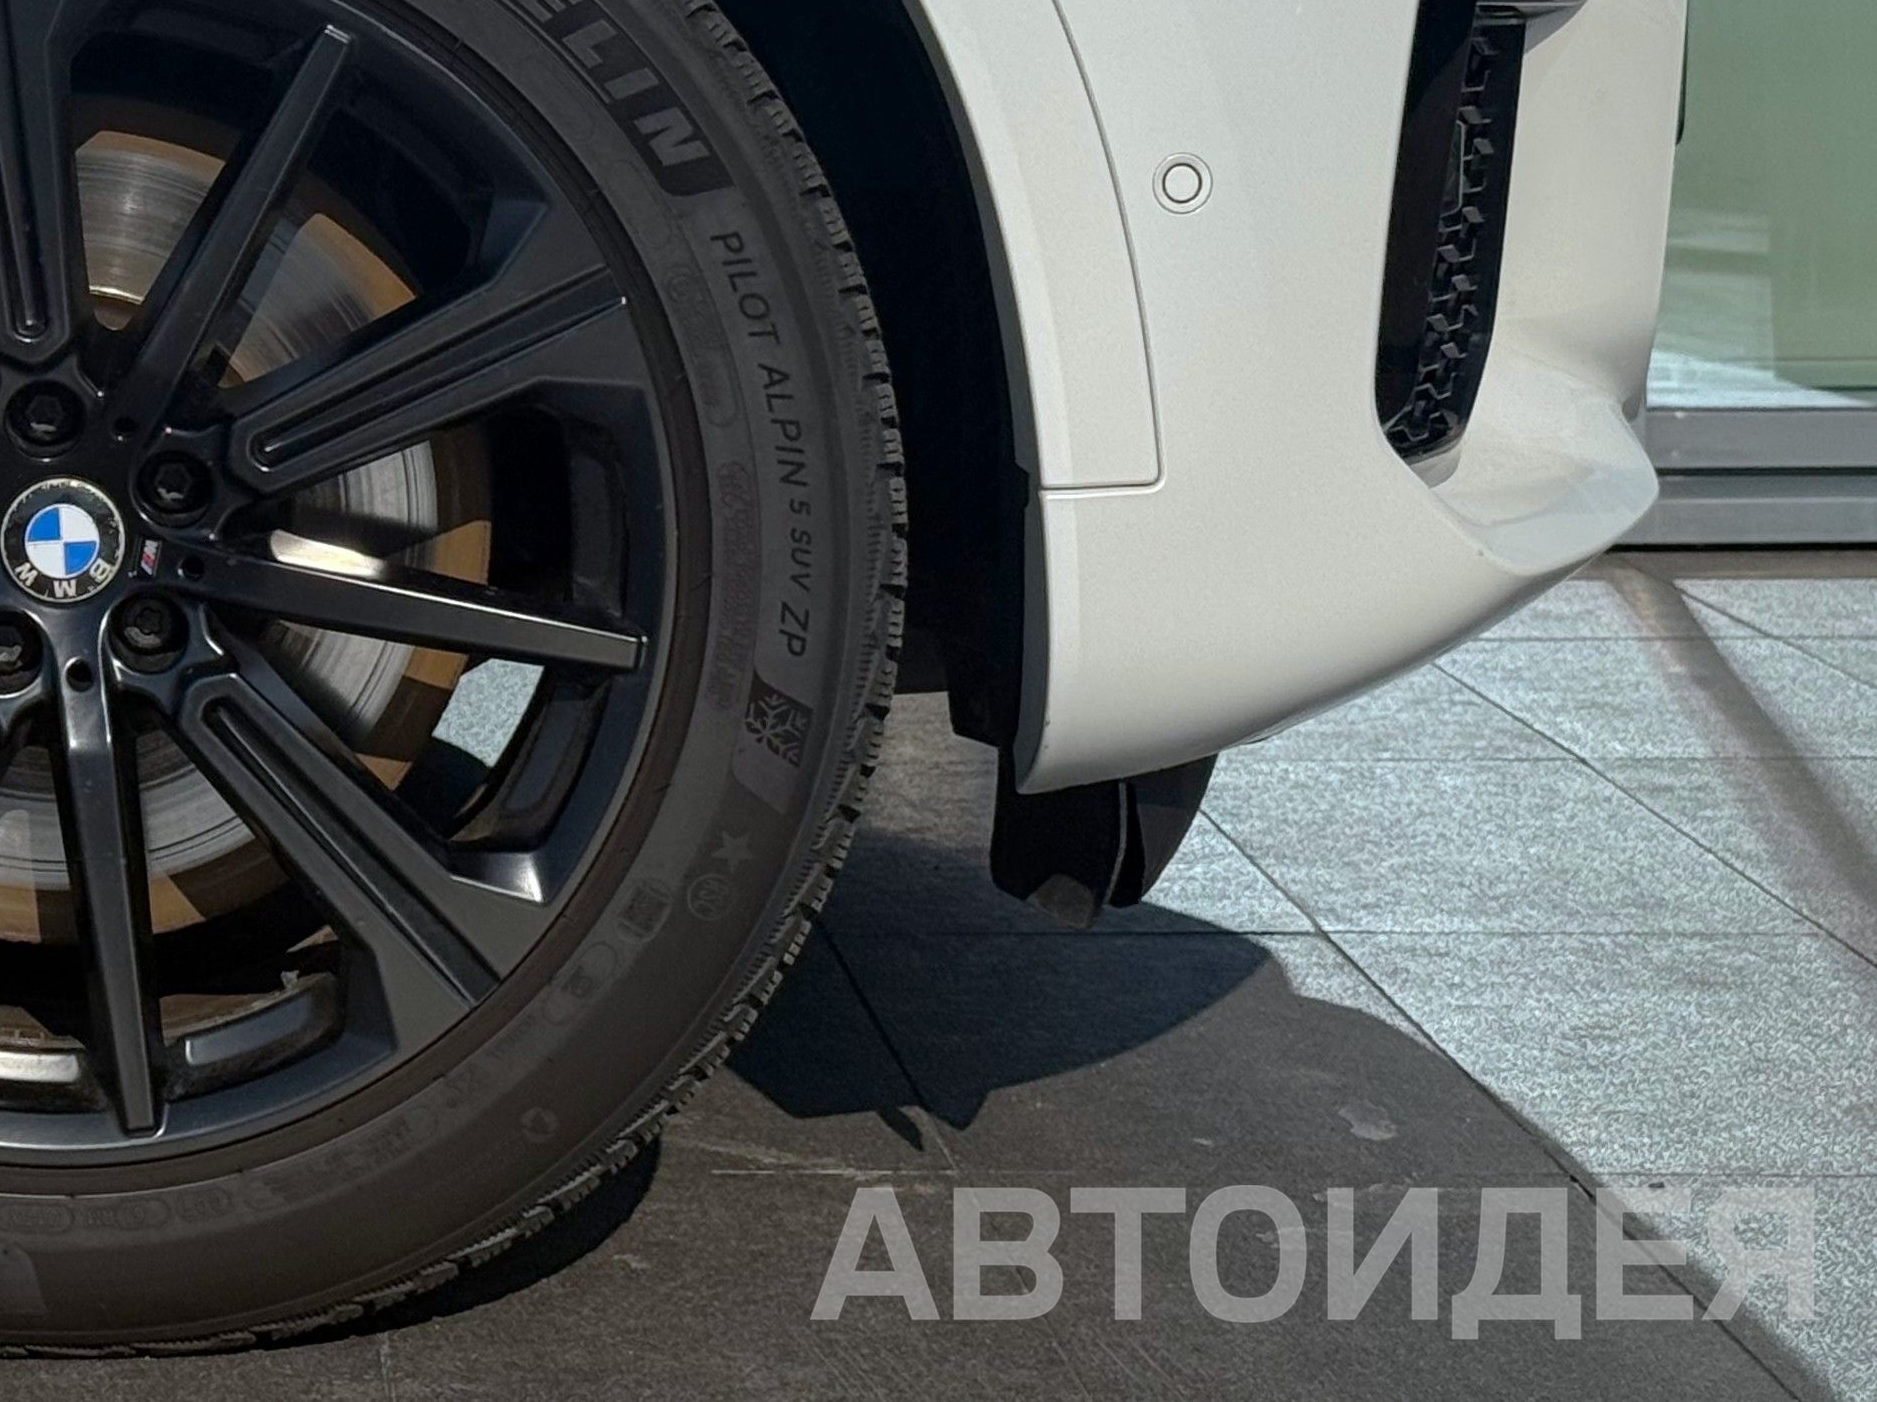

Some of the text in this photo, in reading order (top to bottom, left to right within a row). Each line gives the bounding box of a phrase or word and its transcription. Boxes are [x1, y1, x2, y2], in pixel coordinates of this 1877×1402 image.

[710, 230, 782, 343] PILOT
[757, 361, 806, 486] ALPIN
[14, 557, 113, 599] BMW
[789, 530, 813, 593] SUV
[777, 606, 810, 659] ZP
